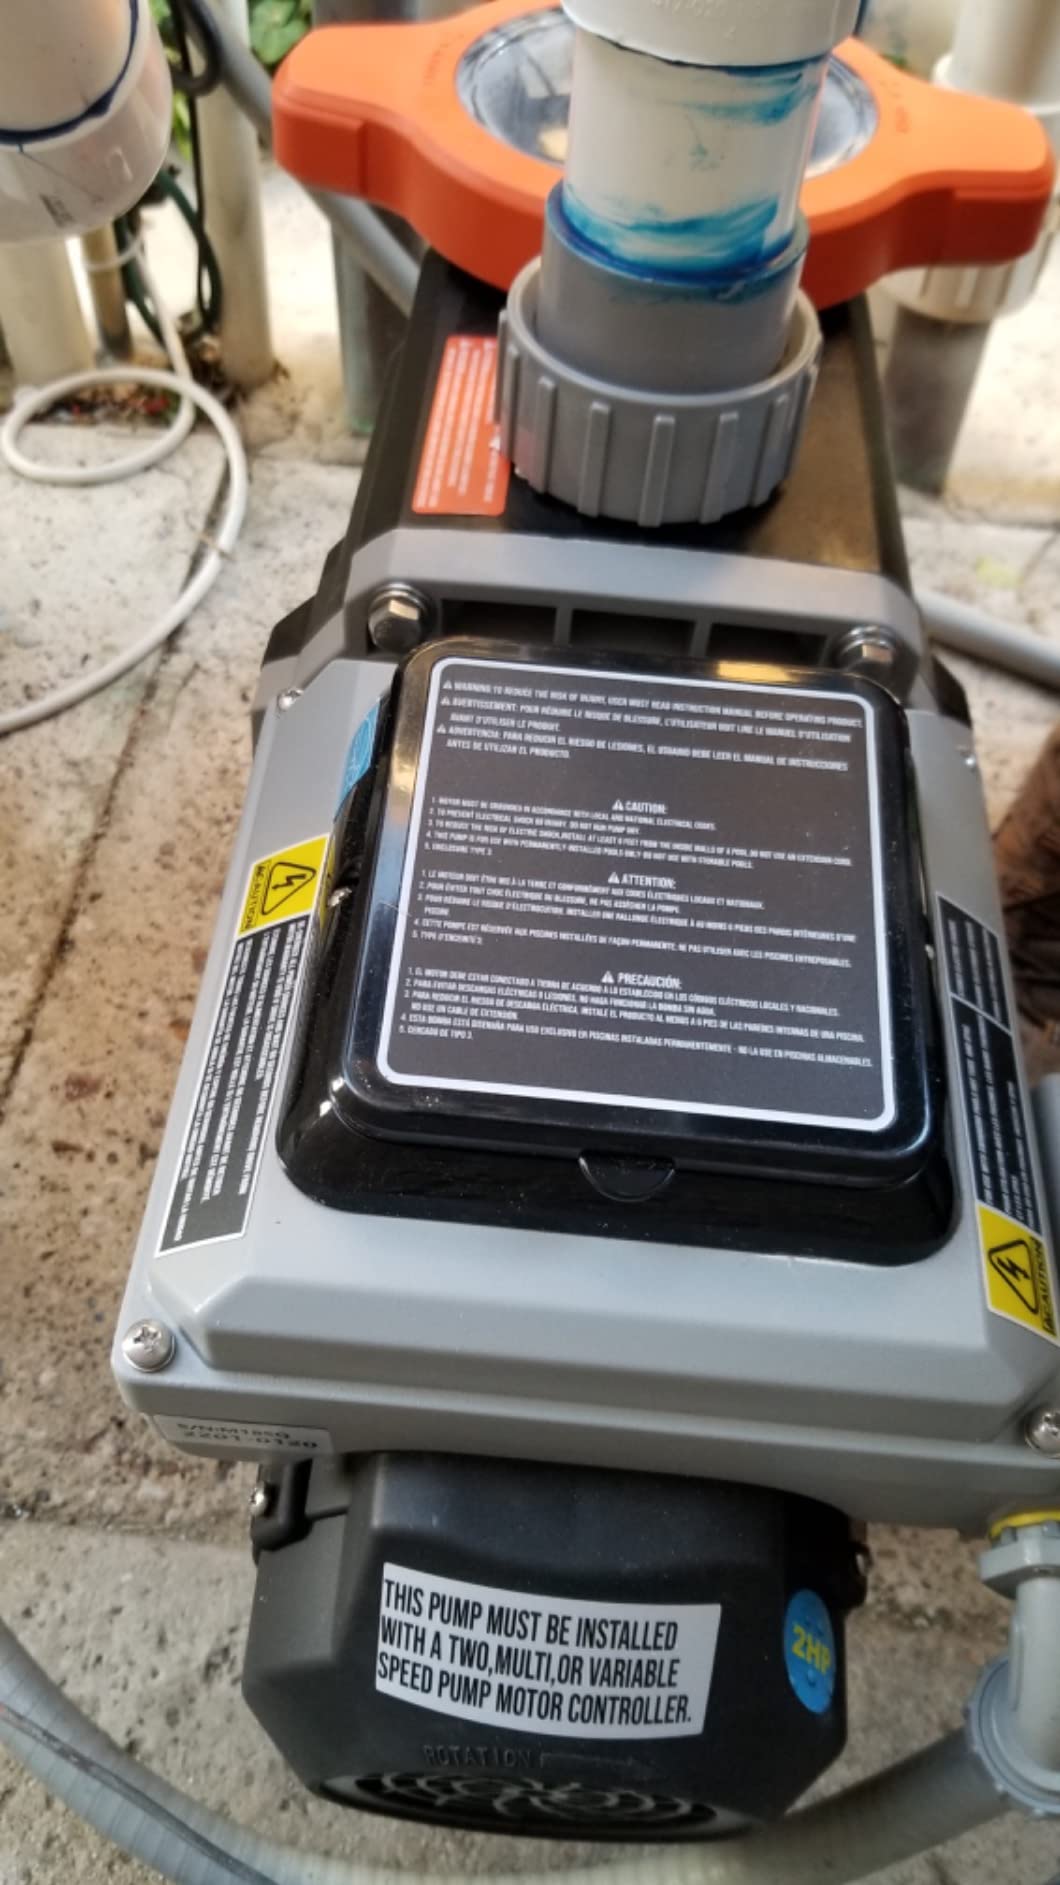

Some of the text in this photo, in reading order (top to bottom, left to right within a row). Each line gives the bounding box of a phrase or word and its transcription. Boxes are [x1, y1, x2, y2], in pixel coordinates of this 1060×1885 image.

[625, 800, 668, 814] CAUTION:
[621, 873, 677, 889] ATTENTION:
[617, 971, 683, 989] PRECAUCIÓN:
[385, 1579, 678, 1651] THIS PUMP MUST BE INSTALLED
[381, 1615, 426, 1656] WITH
[430, 1631, 441, 1660] A
[590, 1656, 680, 1688] VARIABLE
[792, 1621, 831, 1676] 2HP
[378, 1652, 691, 1725] SPEED PUMP MOTOR CONTROLLER.
[423, 1744, 531, 1769] ROTATION
